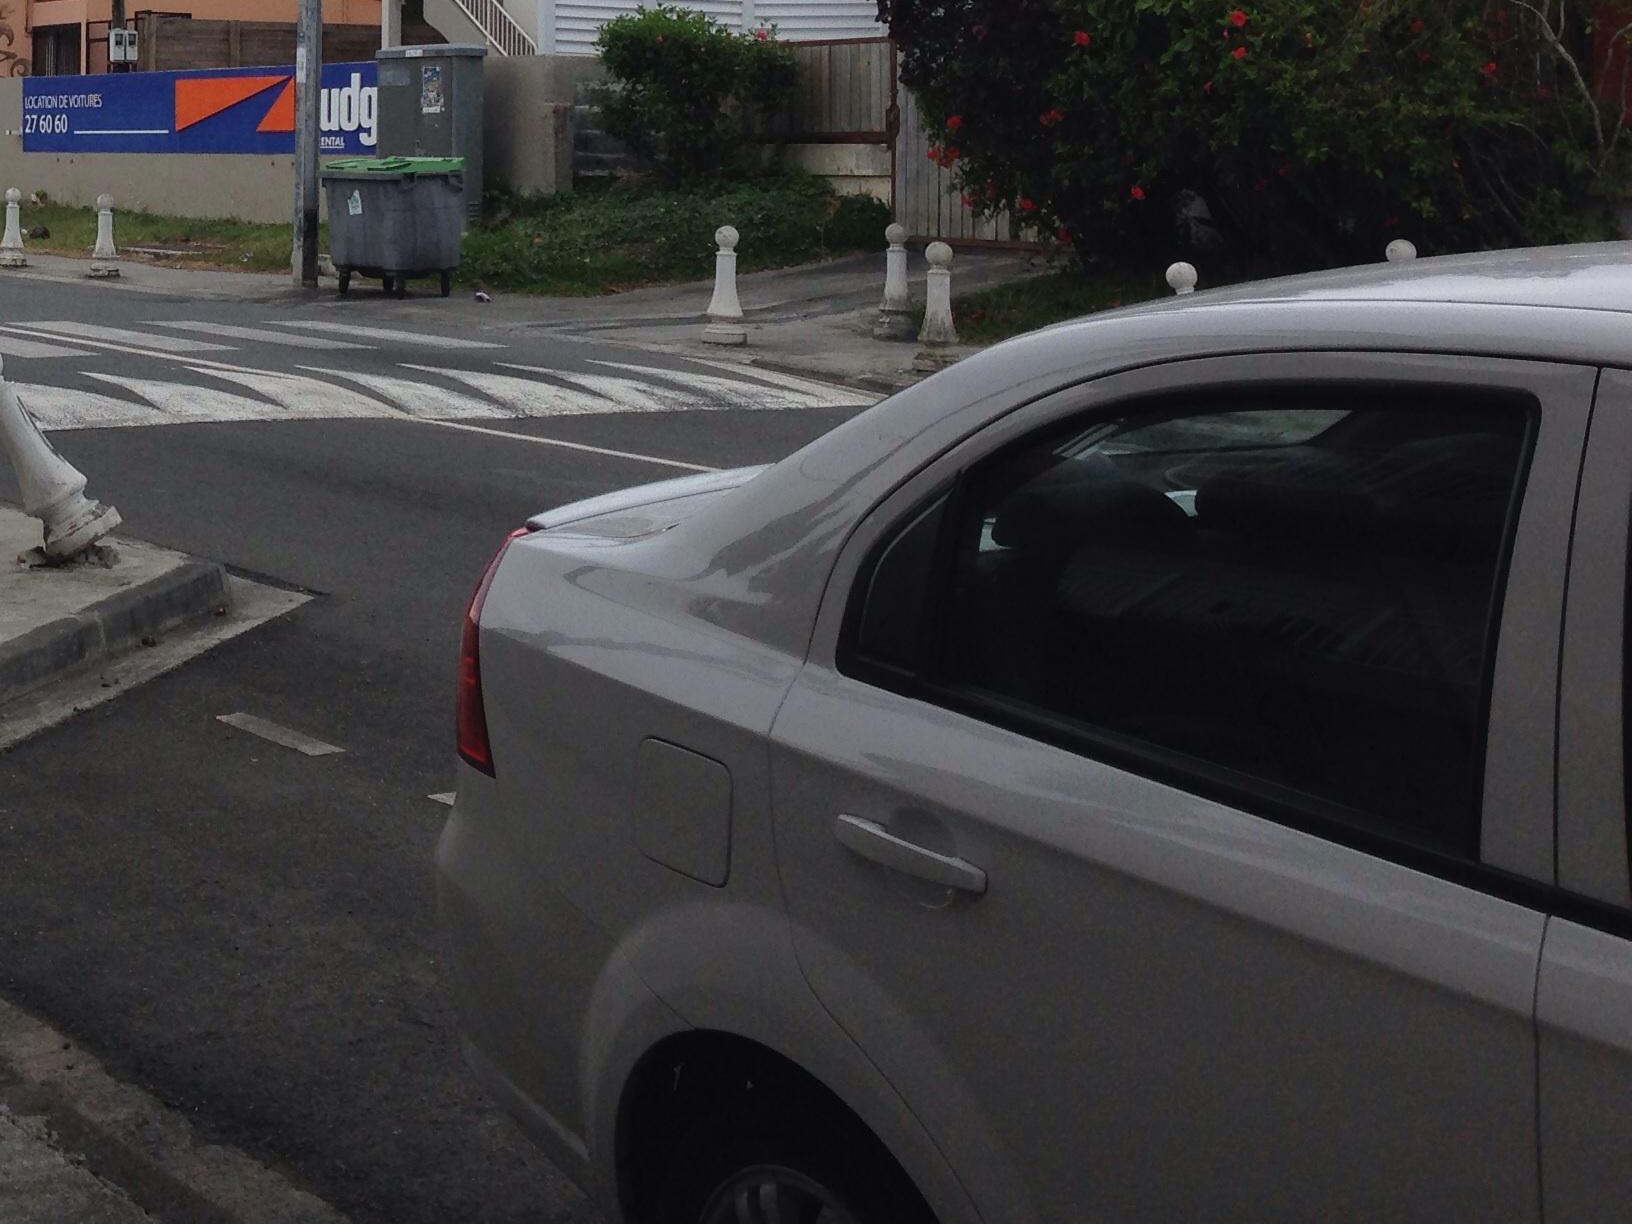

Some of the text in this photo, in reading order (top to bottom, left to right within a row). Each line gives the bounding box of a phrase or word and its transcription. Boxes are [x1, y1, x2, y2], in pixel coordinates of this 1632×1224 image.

[24, 93, 103, 109] LOCATION DE VOITURES
[319, 72, 378, 146] udg
[24, 113, 68, 134] 27 60 60
[319, 136, 345, 146] ENTAL
